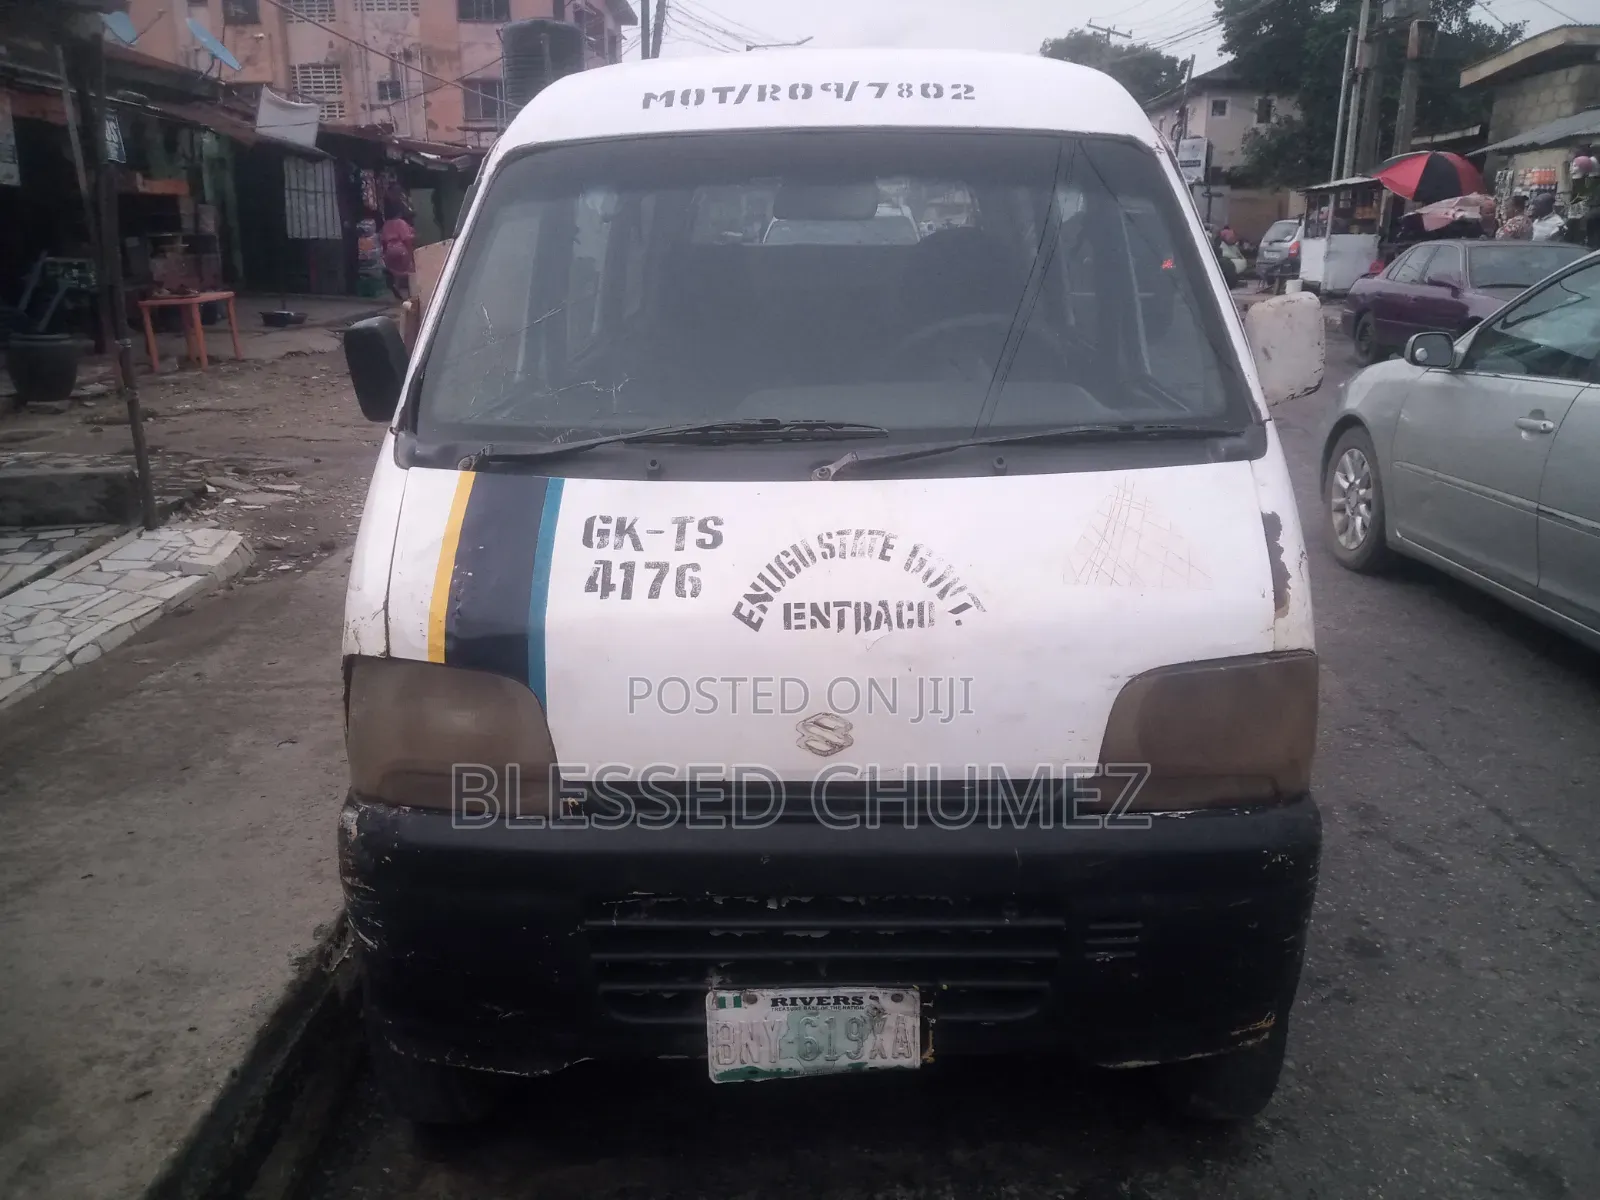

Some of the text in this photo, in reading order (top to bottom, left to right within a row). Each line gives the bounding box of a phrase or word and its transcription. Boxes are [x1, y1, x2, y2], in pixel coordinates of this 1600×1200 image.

[582, 515, 724, 552] GK-TS
[584, 560, 703, 600] 4176
[732, 538, 818, 632] ENUGU
[816, 528, 899, 563] STATE
[782, 600, 935, 635] ENTRACO
[770, 995, 864, 1008] RIVERS
